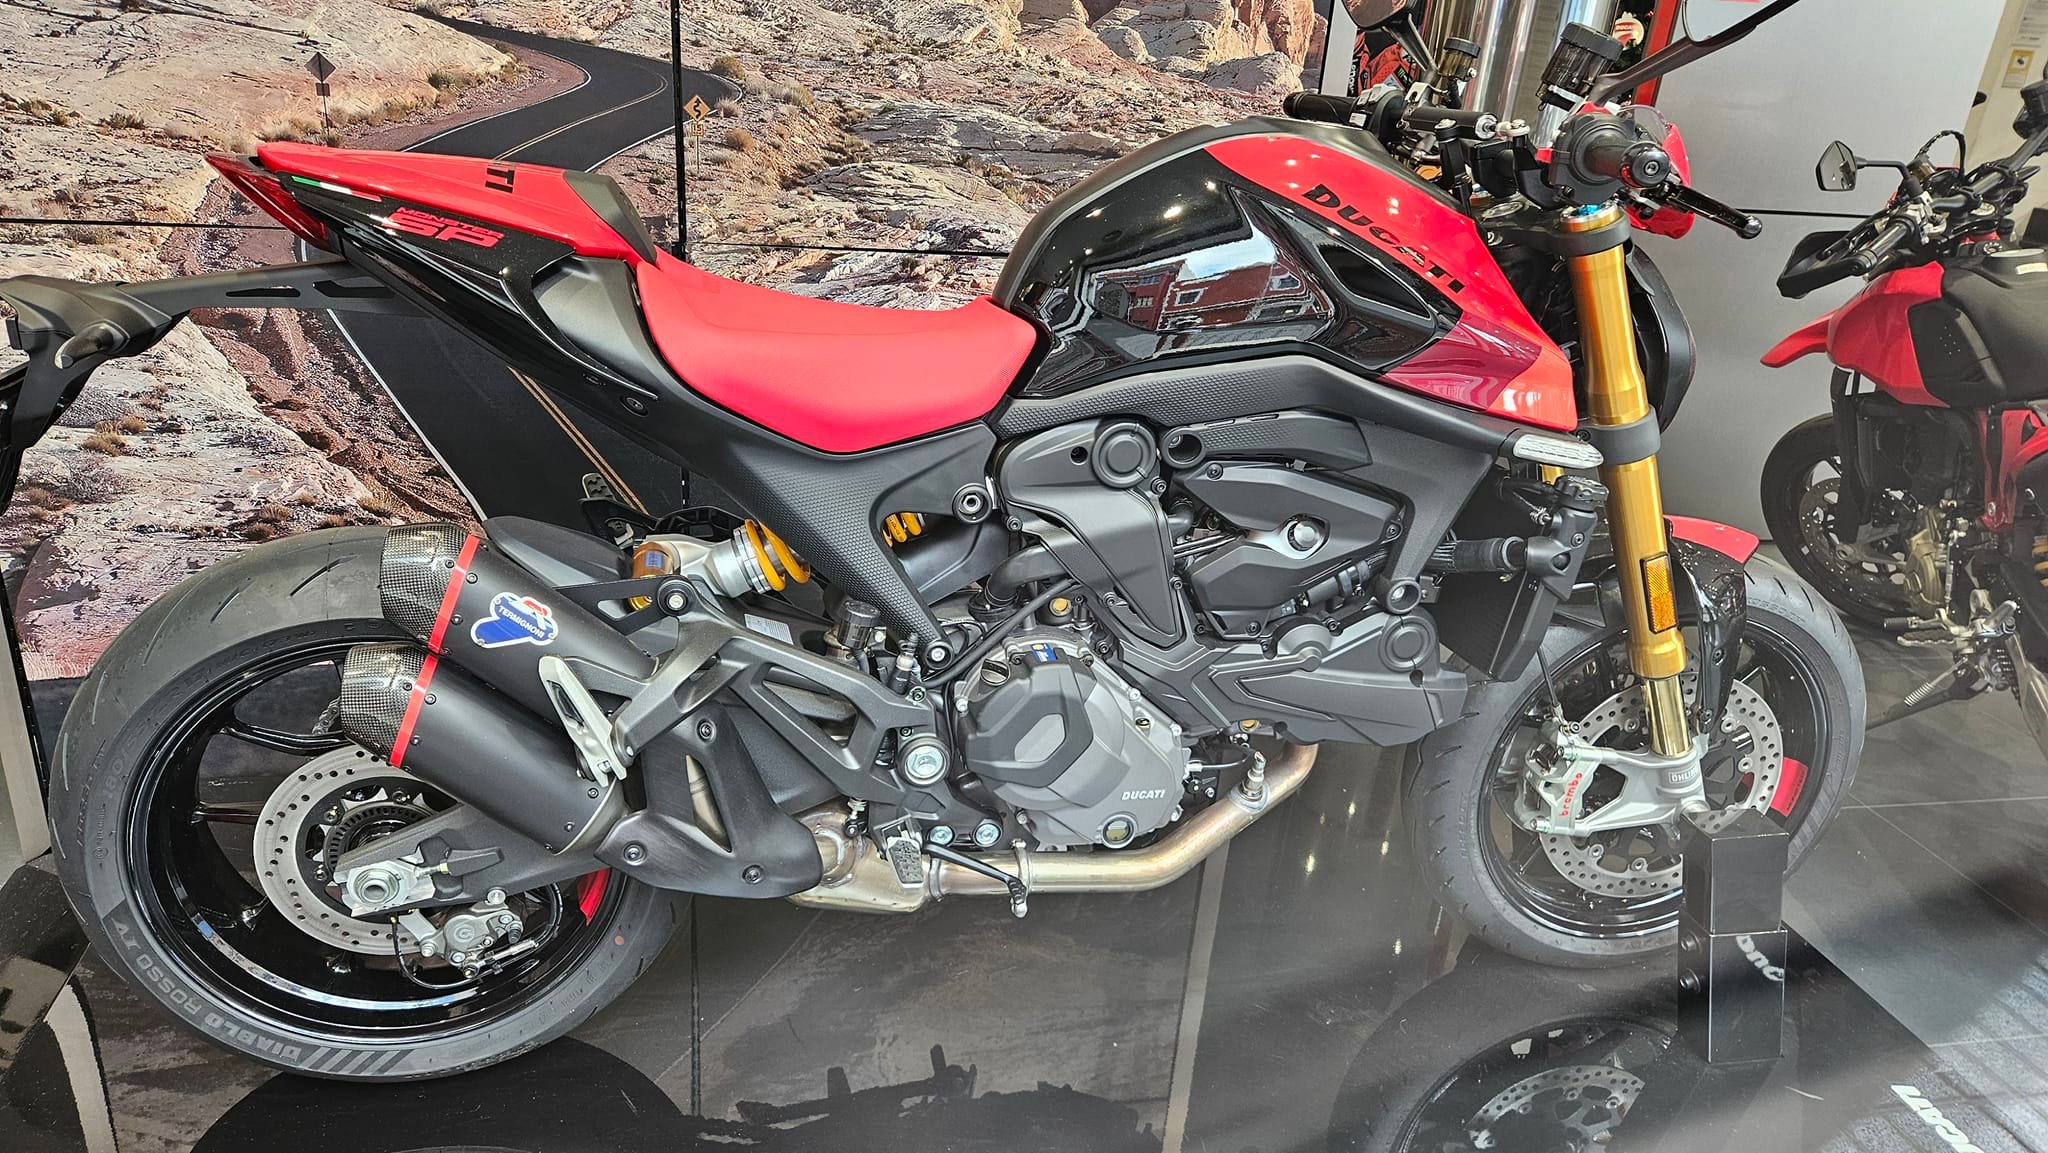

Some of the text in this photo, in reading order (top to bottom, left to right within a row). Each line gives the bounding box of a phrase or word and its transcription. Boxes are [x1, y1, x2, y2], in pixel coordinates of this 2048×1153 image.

[382, 212, 500, 248] SP
[396, 206, 505, 239] MONSTER
[1302, 184, 1465, 294] DUCATI
[498, 605, 546, 639] TERMIGNONI
[1121, 789, 1166, 801] DUCATI
[1559, 773, 1583, 817] brembo
[135, 953, 202, 1015] ROSSO
[205, 1012, 303, 1062] DIABLO
